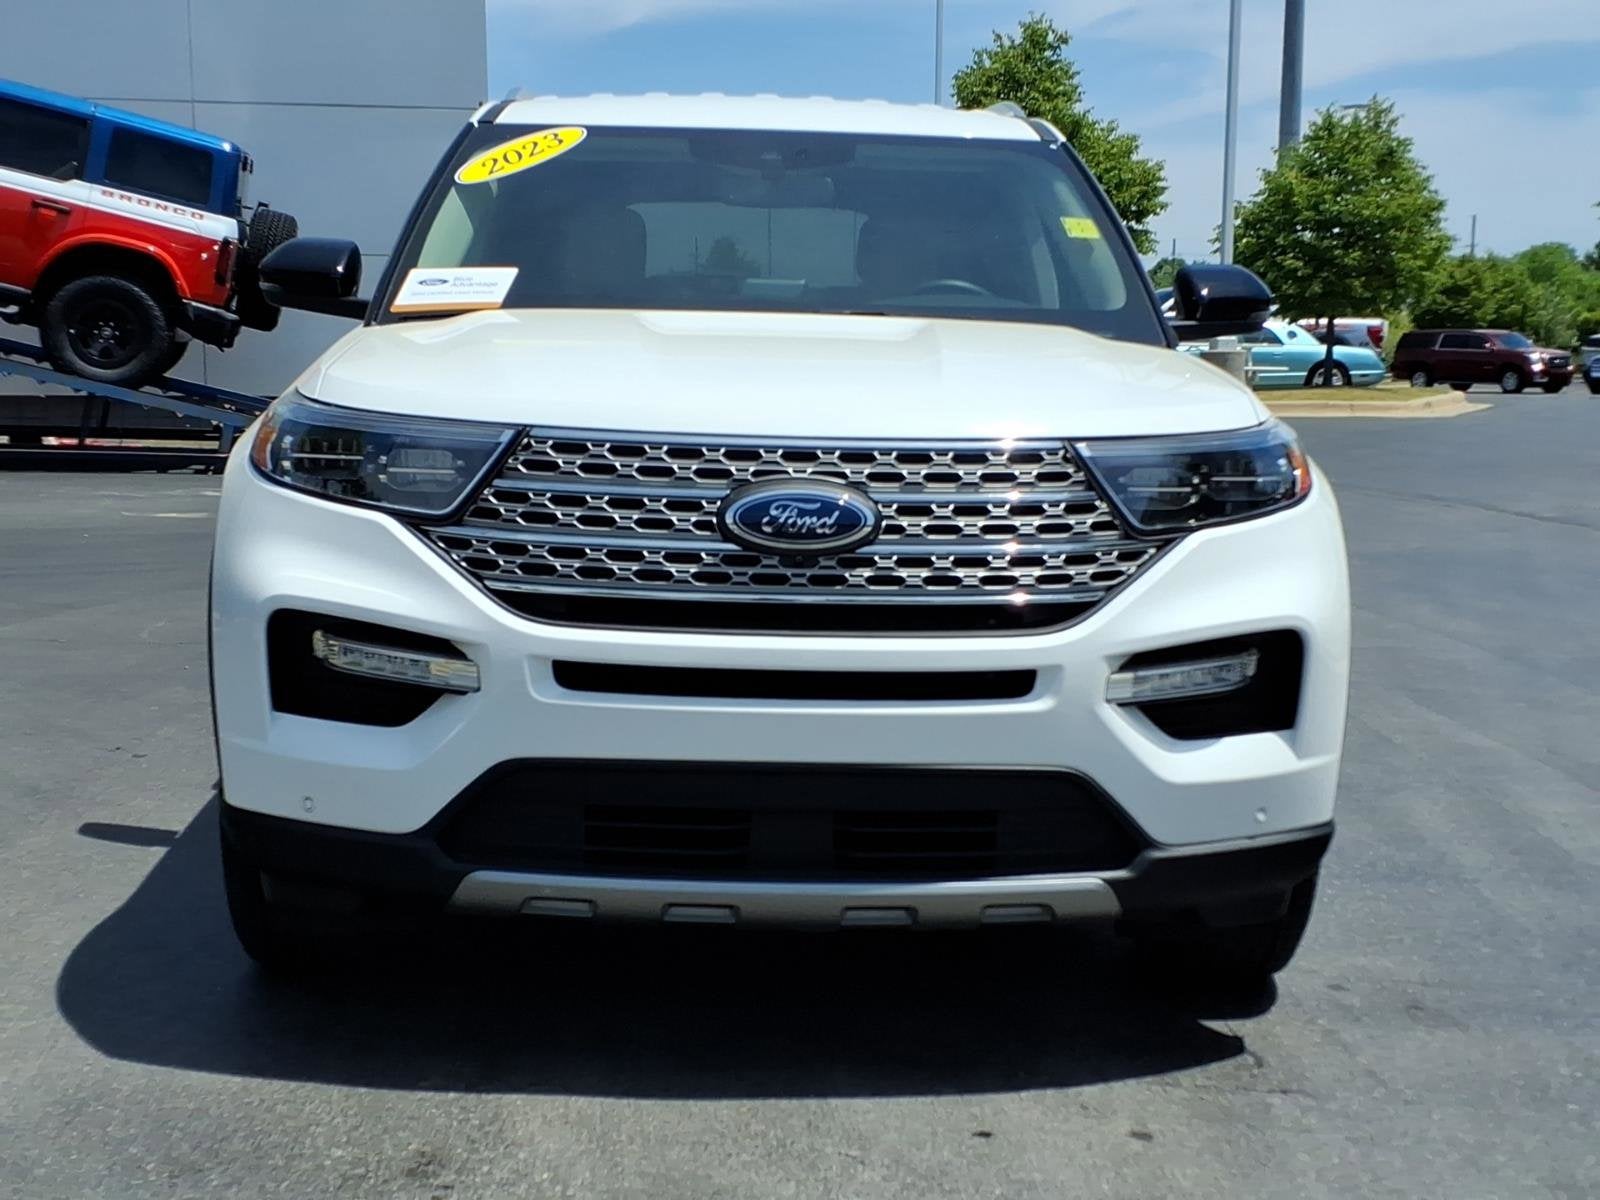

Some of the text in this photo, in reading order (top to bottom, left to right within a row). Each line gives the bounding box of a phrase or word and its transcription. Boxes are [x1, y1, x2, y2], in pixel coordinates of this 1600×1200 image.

[481, 132, 564, 175] 2023
[100, 189, 205, 220] BRONCO
[761, 500, 840, 534] Ford
